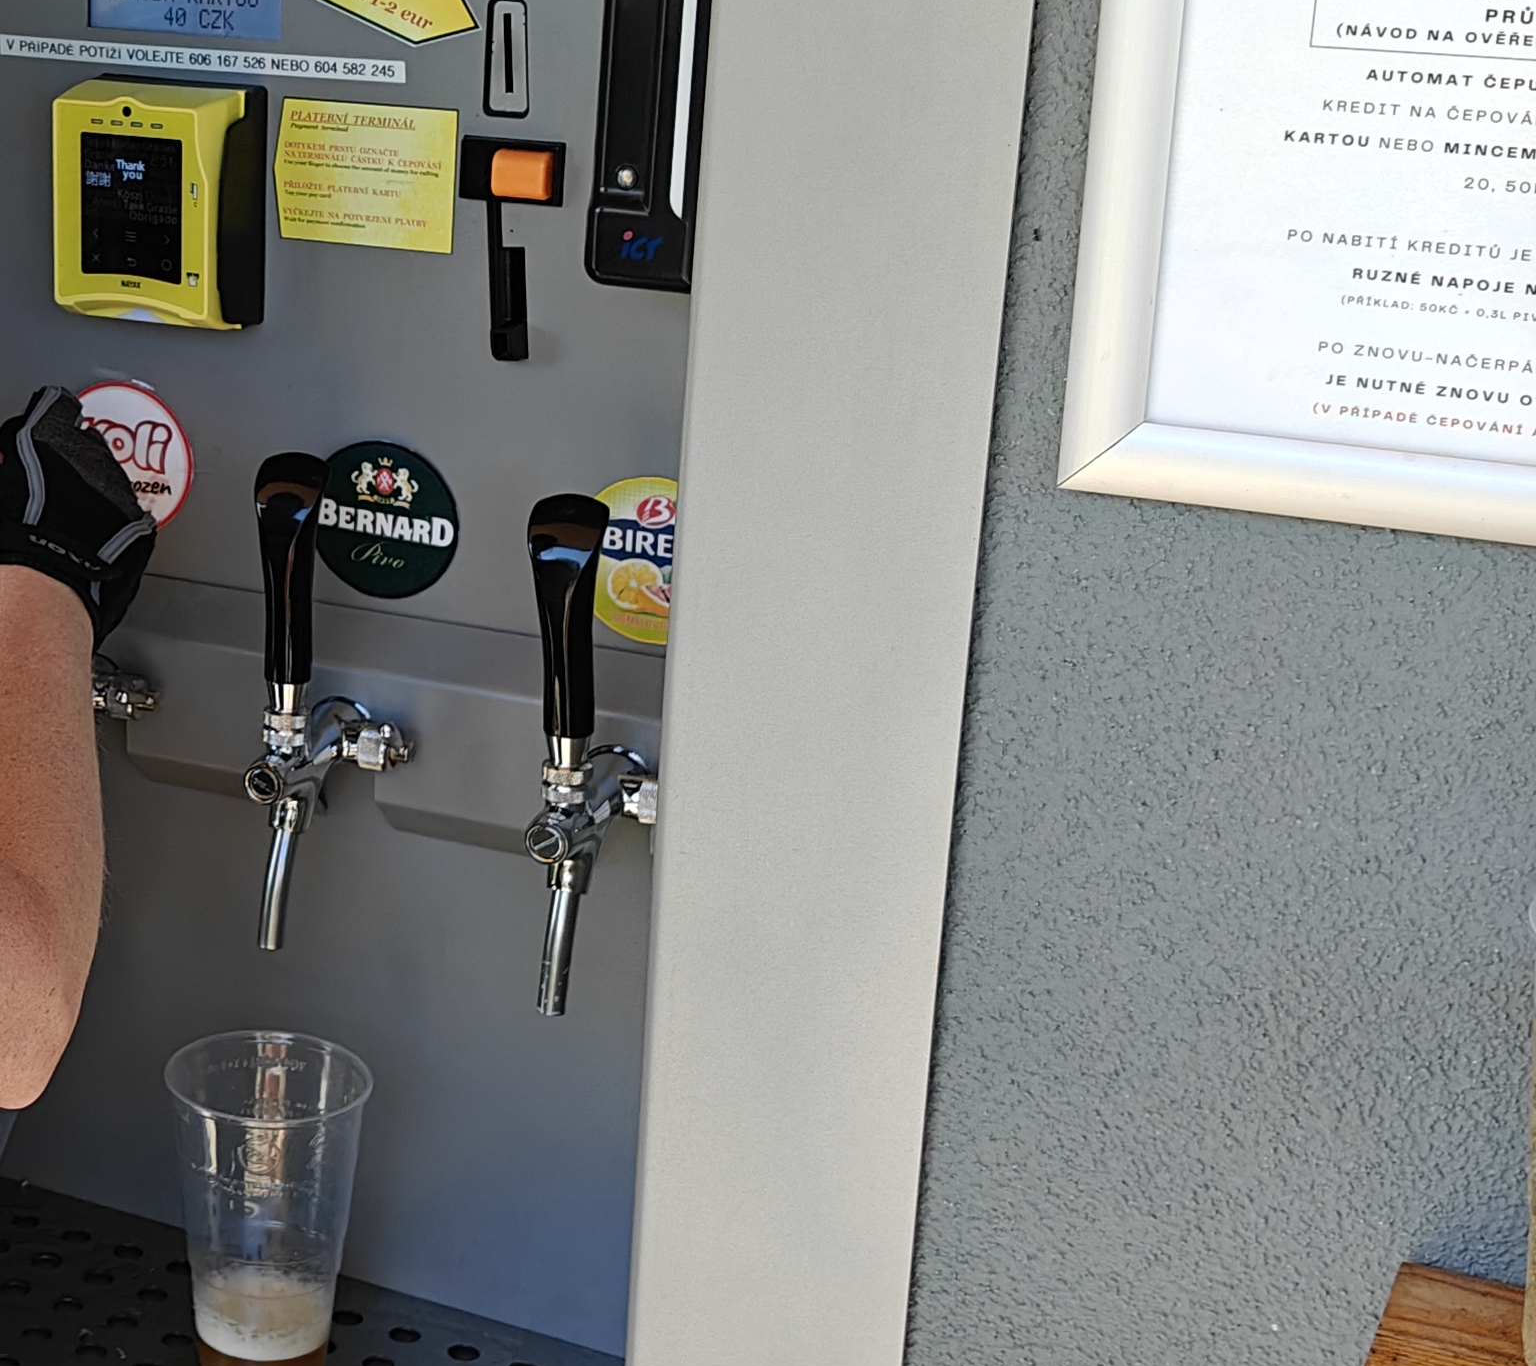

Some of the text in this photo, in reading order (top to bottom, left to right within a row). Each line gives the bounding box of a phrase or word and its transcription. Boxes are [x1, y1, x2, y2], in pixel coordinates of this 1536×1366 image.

[164, 7, 234, 31] 40 CZK
[400, 8, 434, 30] eur
[1336, 22, 1536, 47] (NÁVOD NA OVĚŘE
[6, 39, 15, 51] V
[127, 48, 184, 64] VOLEJTE
[188, 52, 212, 66] 606
[217, 54, 238, 68] 167
[243, 56, 266, 70] 526
[271, 58, 310, 73] NEBO
[314, 61, 337, 74] 604
[342, 62, 366, 76] 582
[371, 64, 395, 78] 245
[1366, 69, 1473, 87] AUTOMAT
[290, 110, 416, 131] PLATEBNÍ TERMINÁL
[1322, 99, 1536, 125] KREDIT NA ČEPOVÁ
[284, 140, 399, 157] DOTYKEM PRSTU OZNAČTE
[1284, 129, 1370, 147] KARTOU
[1378, 137, 1434, 153] NEBO
[115, 158, 145, 172] Thank
[387, 158, 394, 166] K
[122, 171, 143, 182] you
[1464, 177, 1536, 194] 20, 50
[327, 185, 369, 195] PLATEBNÍ
[372, 188, 401, 199] KARTU
[327, 211, 340, 220] NA
[1287, 229, 1313, 243] PO
[1322, 232, 1398, 250] NABITÍ
[1510, 248, 1532, 262] JE
[1352, 268, 1515, 293] RUZNÉ NAPOJE
[1419, 302, 1459, 315] 50KČ
[1318, 340, 1344, 354] PO
[1325, 374, 1509, 403] JE NUTNÉ ZNOVU
[1313, 401, 1331, 415] (V
[1426, 413, 1523, 435] ČEPOVÁNÍ
[131, 480, 172, 496] ozen
[318, 497, 454, 547] BERNARD
[351, 541, 405, 569] Pivo
